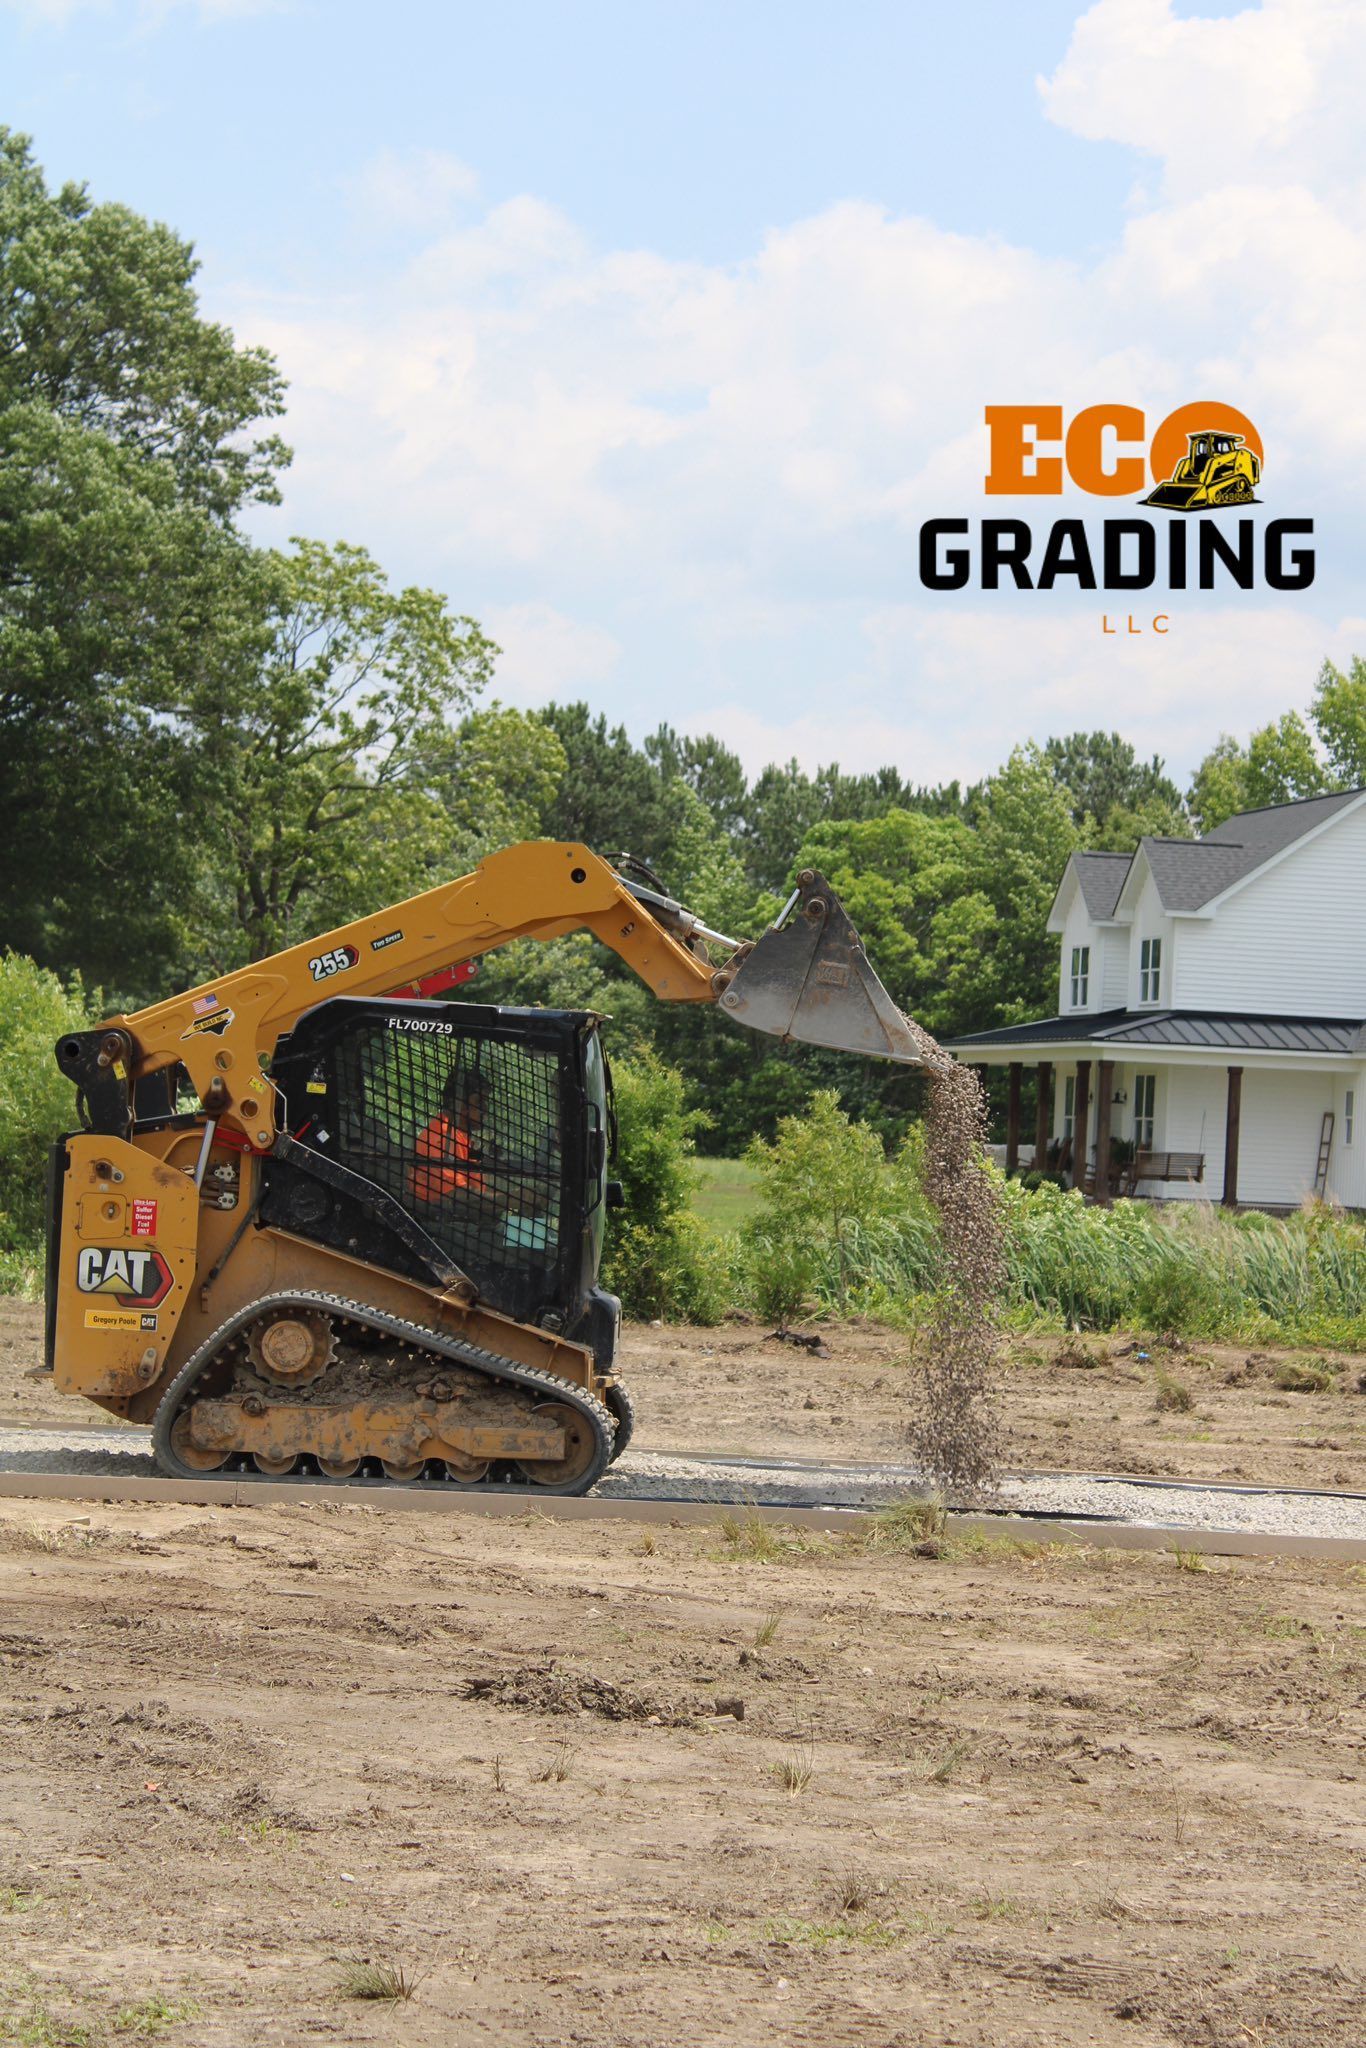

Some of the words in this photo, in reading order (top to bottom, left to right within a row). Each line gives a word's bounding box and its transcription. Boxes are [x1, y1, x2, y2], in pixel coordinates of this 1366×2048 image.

[309, 948, 350, 980] 255
[389, 1018, 453, 1034] FL700729
[137, 1220, 150, 1228] Fuel
[78, 1248, 151, 1294] CAT
[93, 1315, 118, 1325] Gregory
[118, 1317, 137, 1325] Poole
[141, 1317, 156, 1327] CAT
